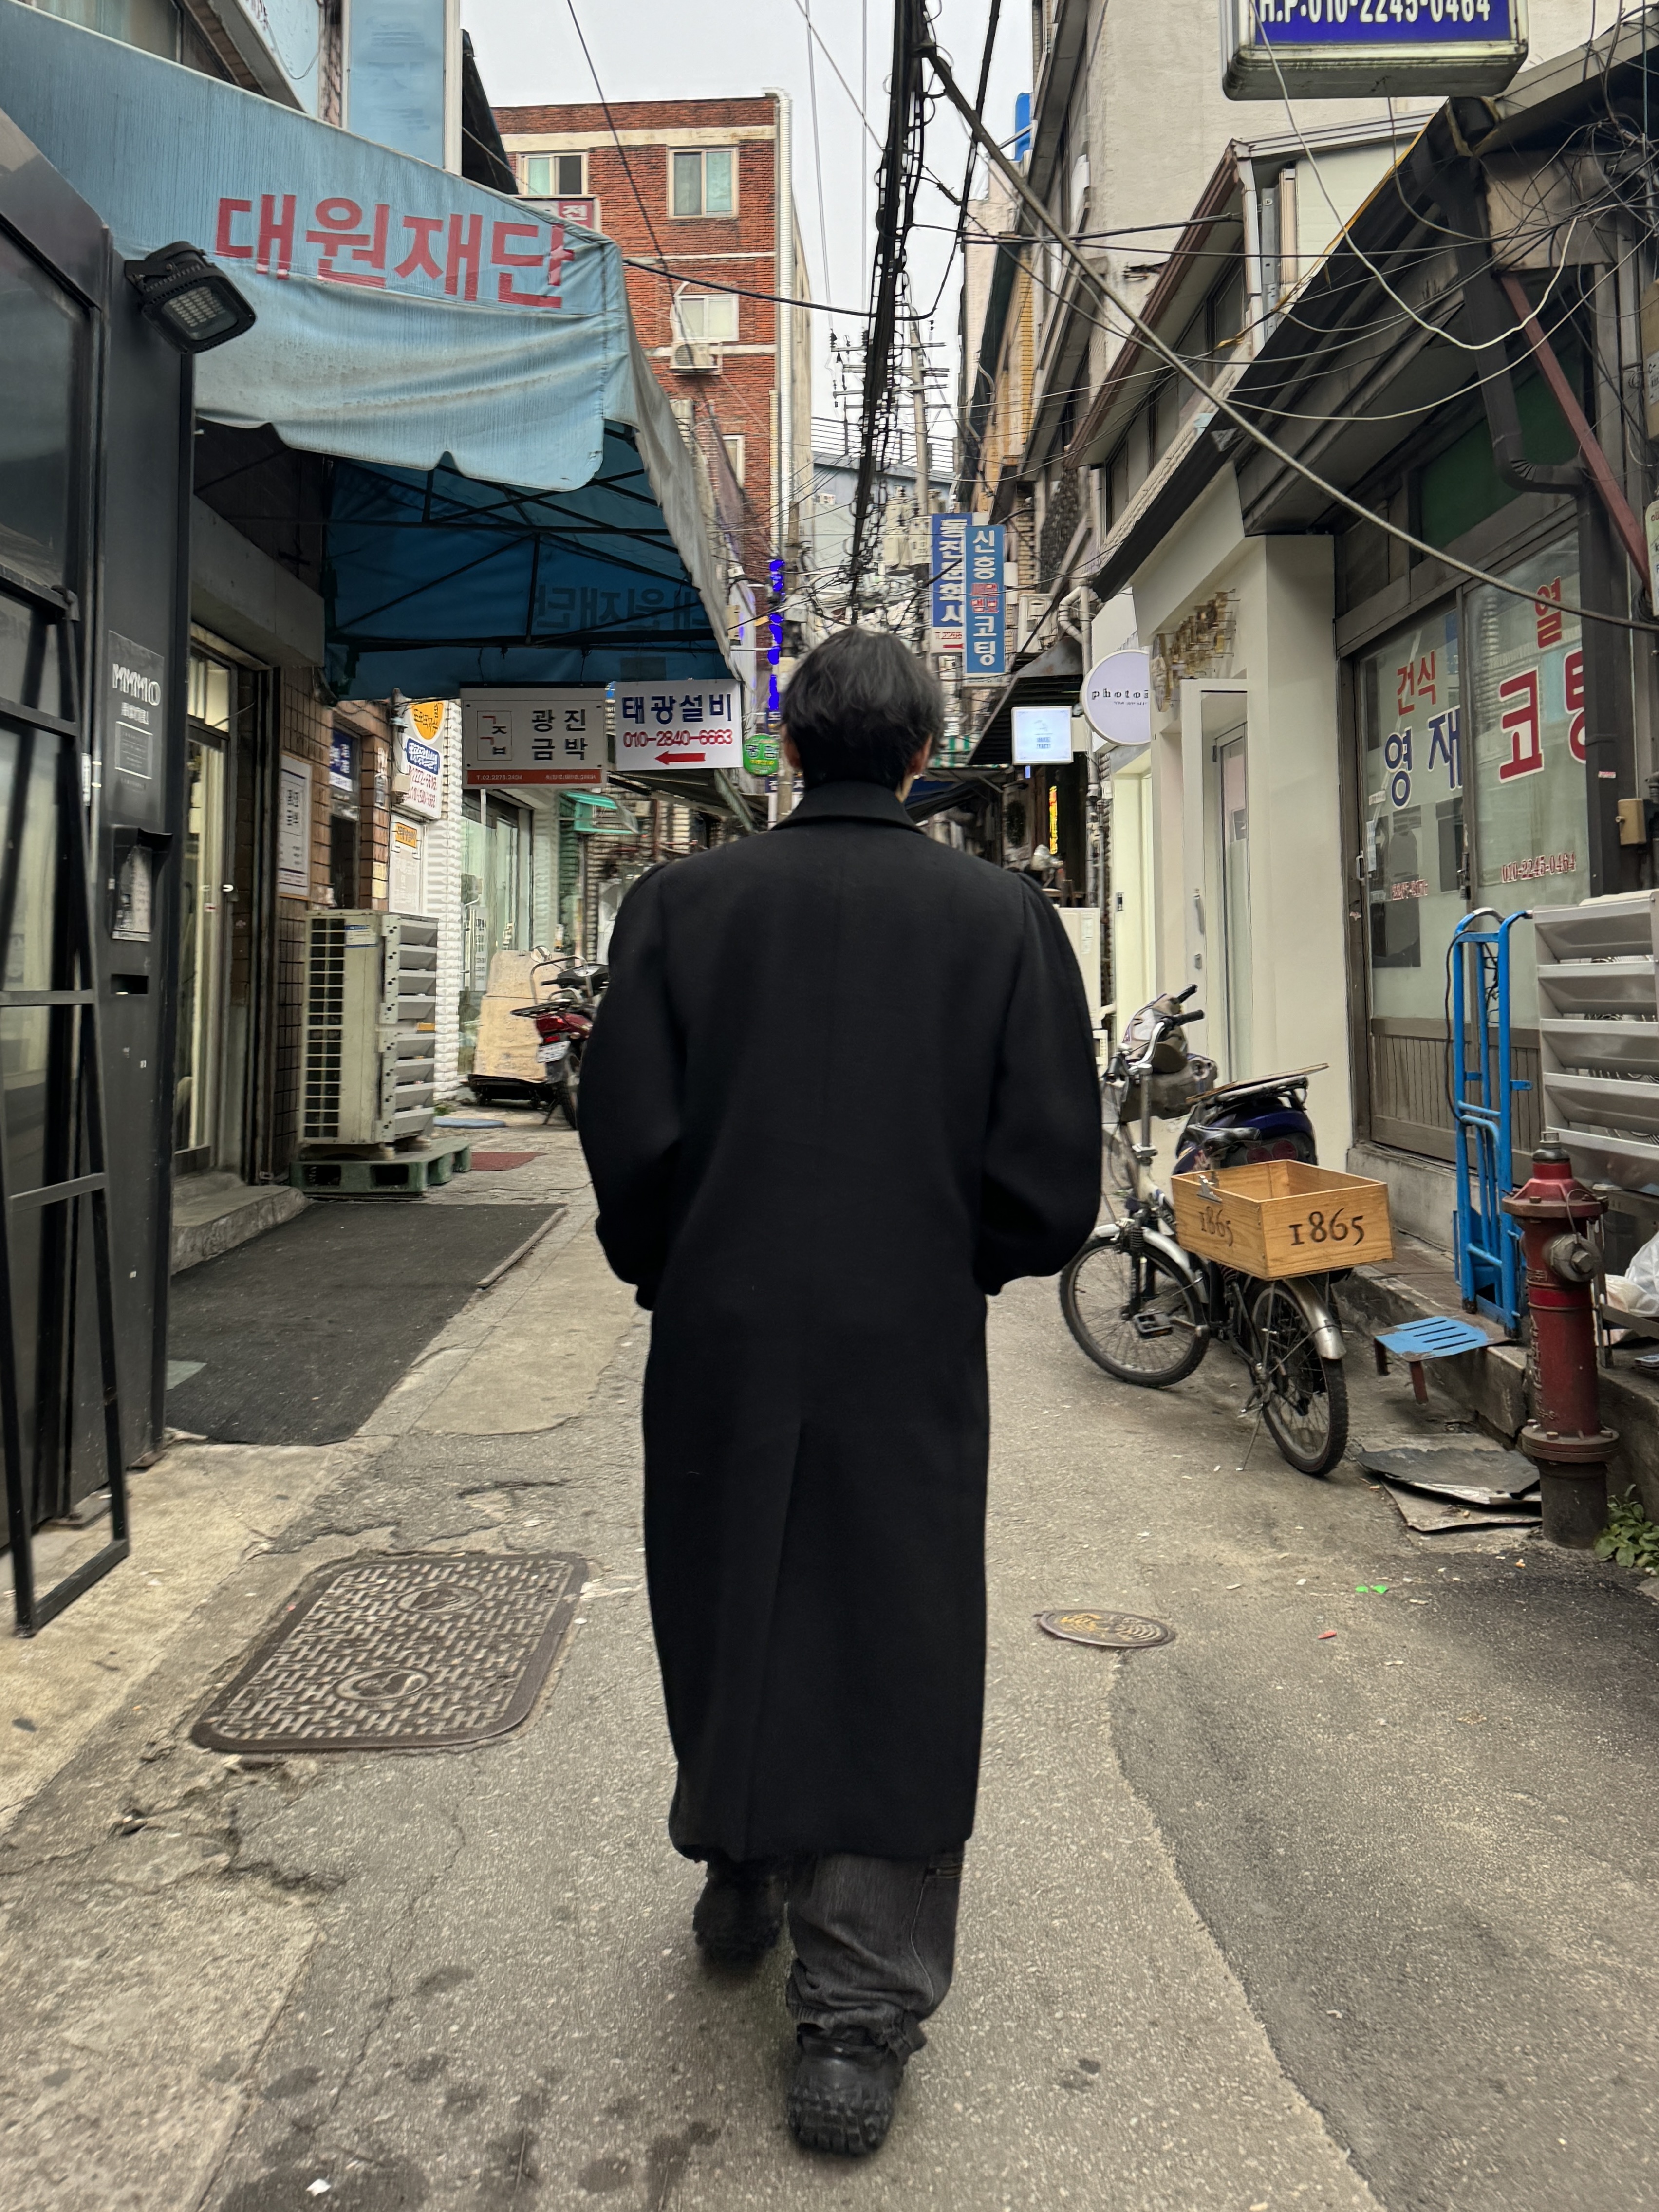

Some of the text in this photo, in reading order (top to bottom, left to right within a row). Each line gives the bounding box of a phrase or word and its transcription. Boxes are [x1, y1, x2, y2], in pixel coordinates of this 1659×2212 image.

[215, 194, 575, 309] 대원재단
[973, 530, 996, 579] 신흥
[973, 616, 997, 666] 코팅
[1397, 650, 1437, 716] 건식
[532, 709, 586, 732] 광진
[621, 694, 732, 725] 태광설비
[532, 737, 589, 761] 금박
[623, 729, 733, 748] 010-2840-6663
[1385, 706, 1463, 809] 영재
[1199, 1206, 1234, 1247] 1865
[1287, 1207, 1365, 1246] 1865
